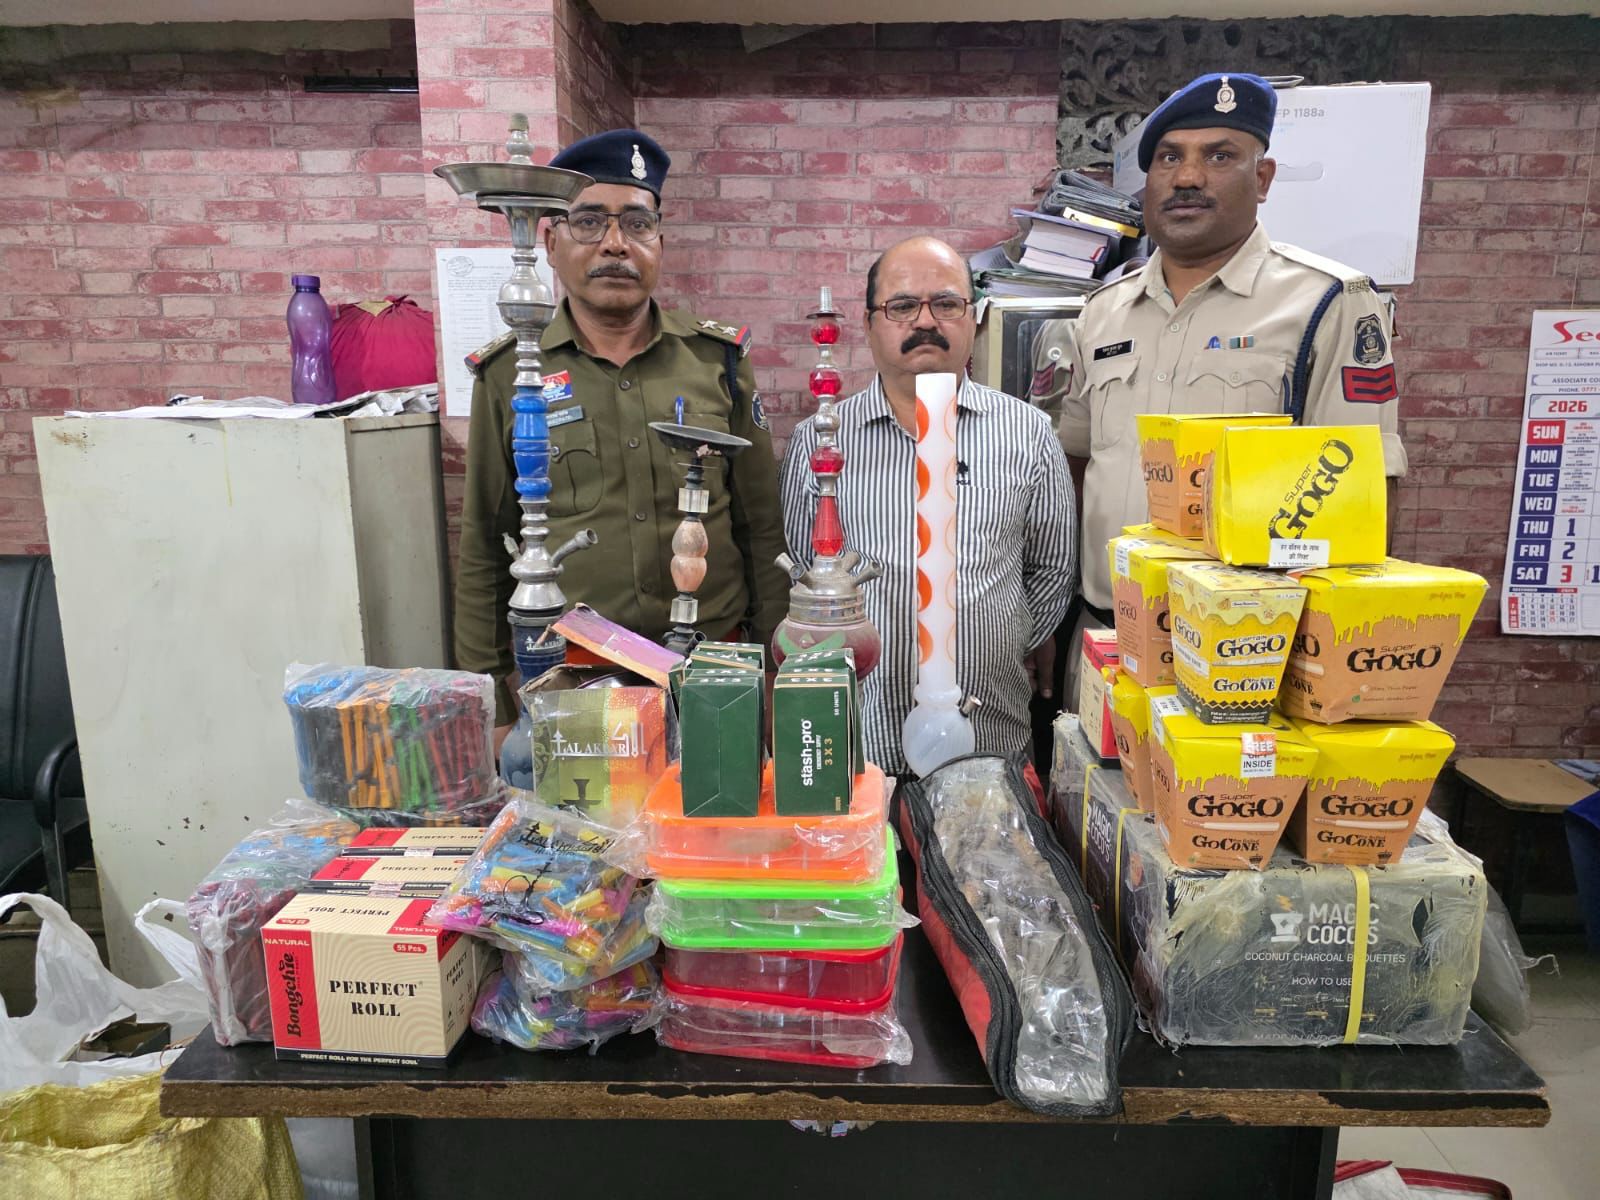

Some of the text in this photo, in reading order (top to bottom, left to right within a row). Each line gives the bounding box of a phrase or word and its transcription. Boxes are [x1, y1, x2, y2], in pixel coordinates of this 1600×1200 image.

[1294, 107, 1325, 118] 1188a
[1551, 318, 1600, 346] Se
[1548, 401, 1588, 413] 2026
[1532, 425, 1560, 439] SUN
[1530, 450, 1557, 463] MON
[1284, 464, 1312, 504] Super
[1529, 474, 1555, 487] TUE
[1525, 497, 1553, 511] WED
[1522, 518, 1576, 536] THU 1
[1520, 542, 1576, 559] FRI 2
[1516, 567, 1543, 580] SAT
[1560, 565, 1573, 583] 3
[1216, 635, 1286, 658] GOGO
[1380, 643, 1417, 653] Super
[1346, 646, 1442, 673] GOGO
[801, 720, 815, 786] stash-pro
[825, 747, 833, 756] X
[825, 758, 833, 766] 3
[1243, 760, 1272, 768] INSIDE
[1188, 795, 1283, 817] GOGO
[1321, 795, 1414, 818] GOGO
[1092, 800, 1111, 843] MAGIC
[340, 908, 390, 916] PERFECT
[1309, 903, 1379, 925] MAGC
[264, 938, 309, 947] NATURAL
[396, 944, 424, 953] 55 Pcs.
[1245, 952, 1290, 962] COCONUT
[1293, 952, 1344, 962] CHARCOAL
[446, 952, 467, 982] PERFECT
[452, 967, 464, 987] ROLL
[1292, 977, 1353, 986] HOW TO USE
[279, 952, 304, 1038] Bongchie
[329, 980, 417, 997] PERFECT
[351, 1001, 401, 1017] ROLL
